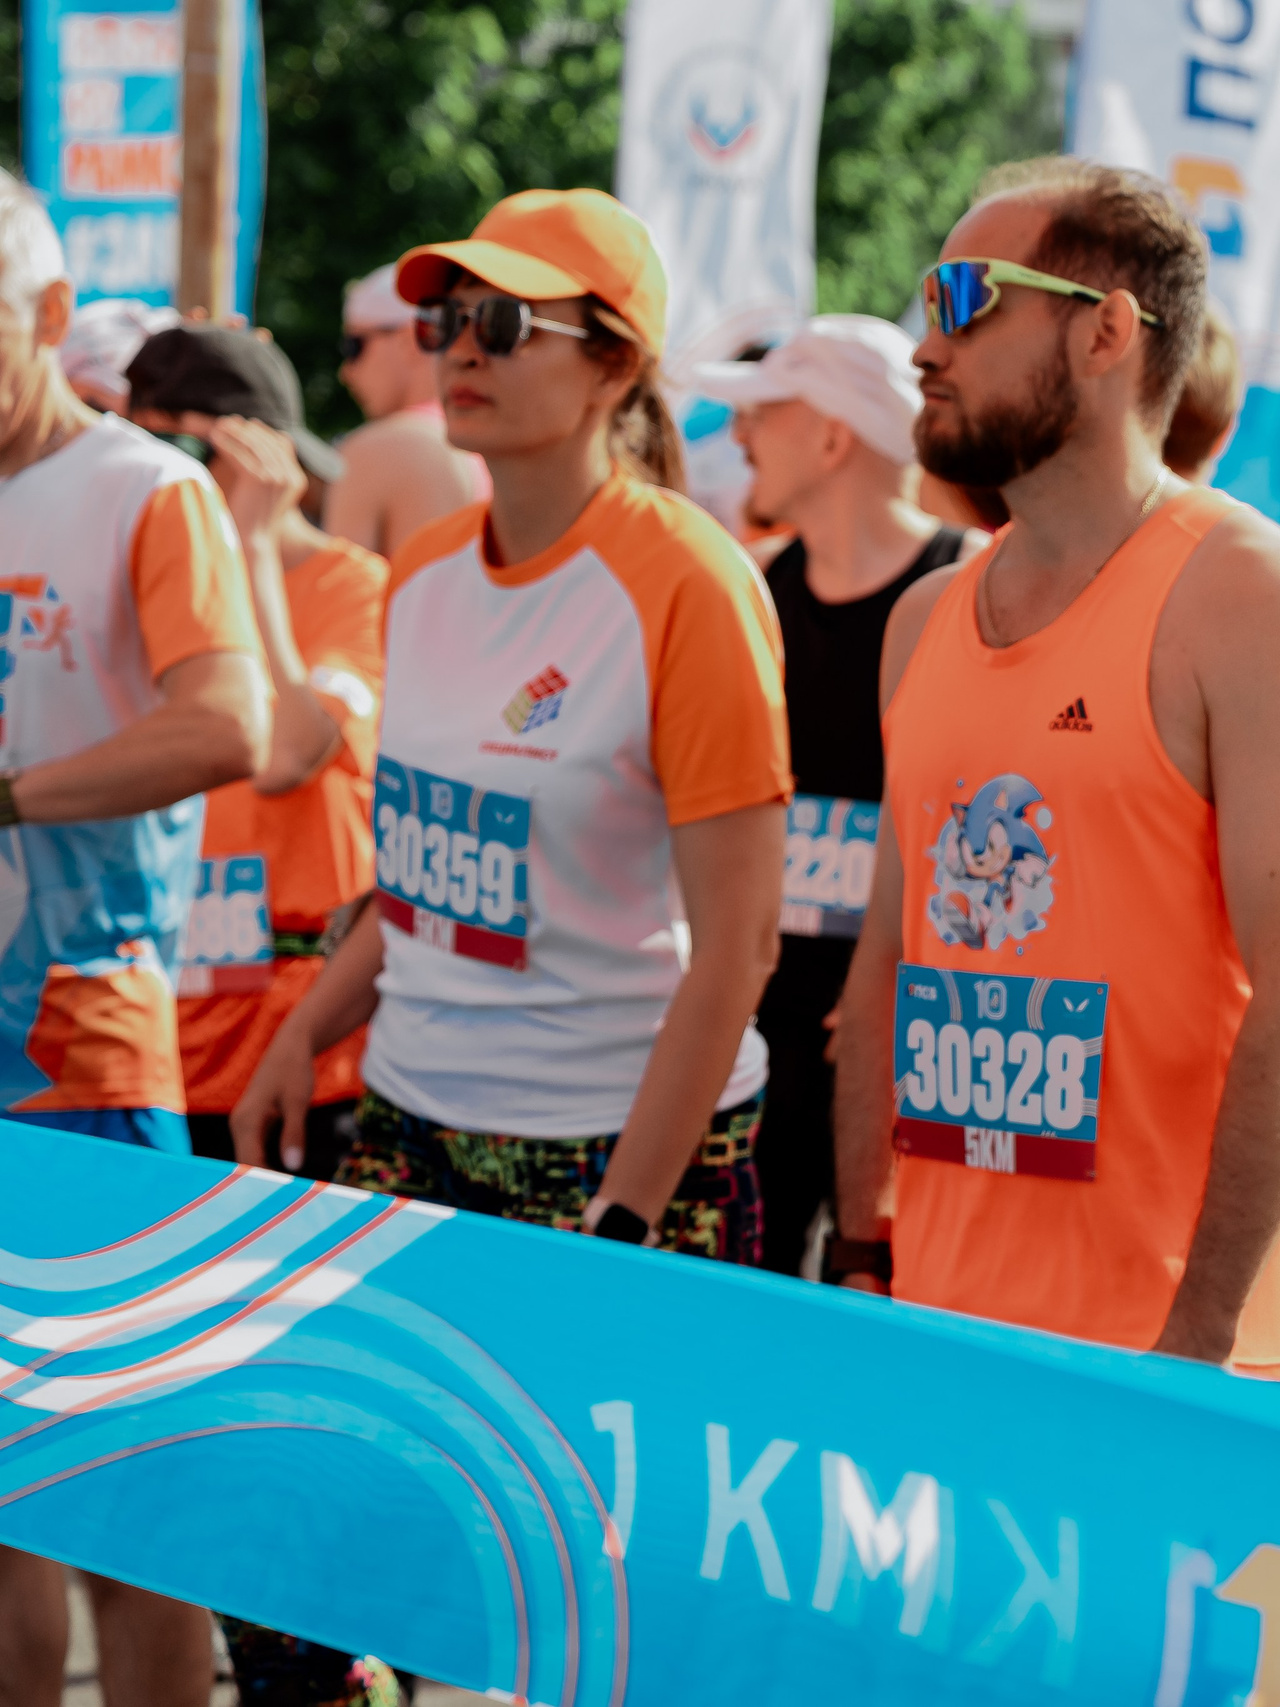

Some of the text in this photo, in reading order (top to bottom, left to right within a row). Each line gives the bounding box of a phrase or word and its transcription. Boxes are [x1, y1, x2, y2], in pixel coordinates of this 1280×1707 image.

[377, 803, 515, 926] 30359
[974, 980, 1007, 1020] 10
[907, 1018, 1085, 1130] 30328
